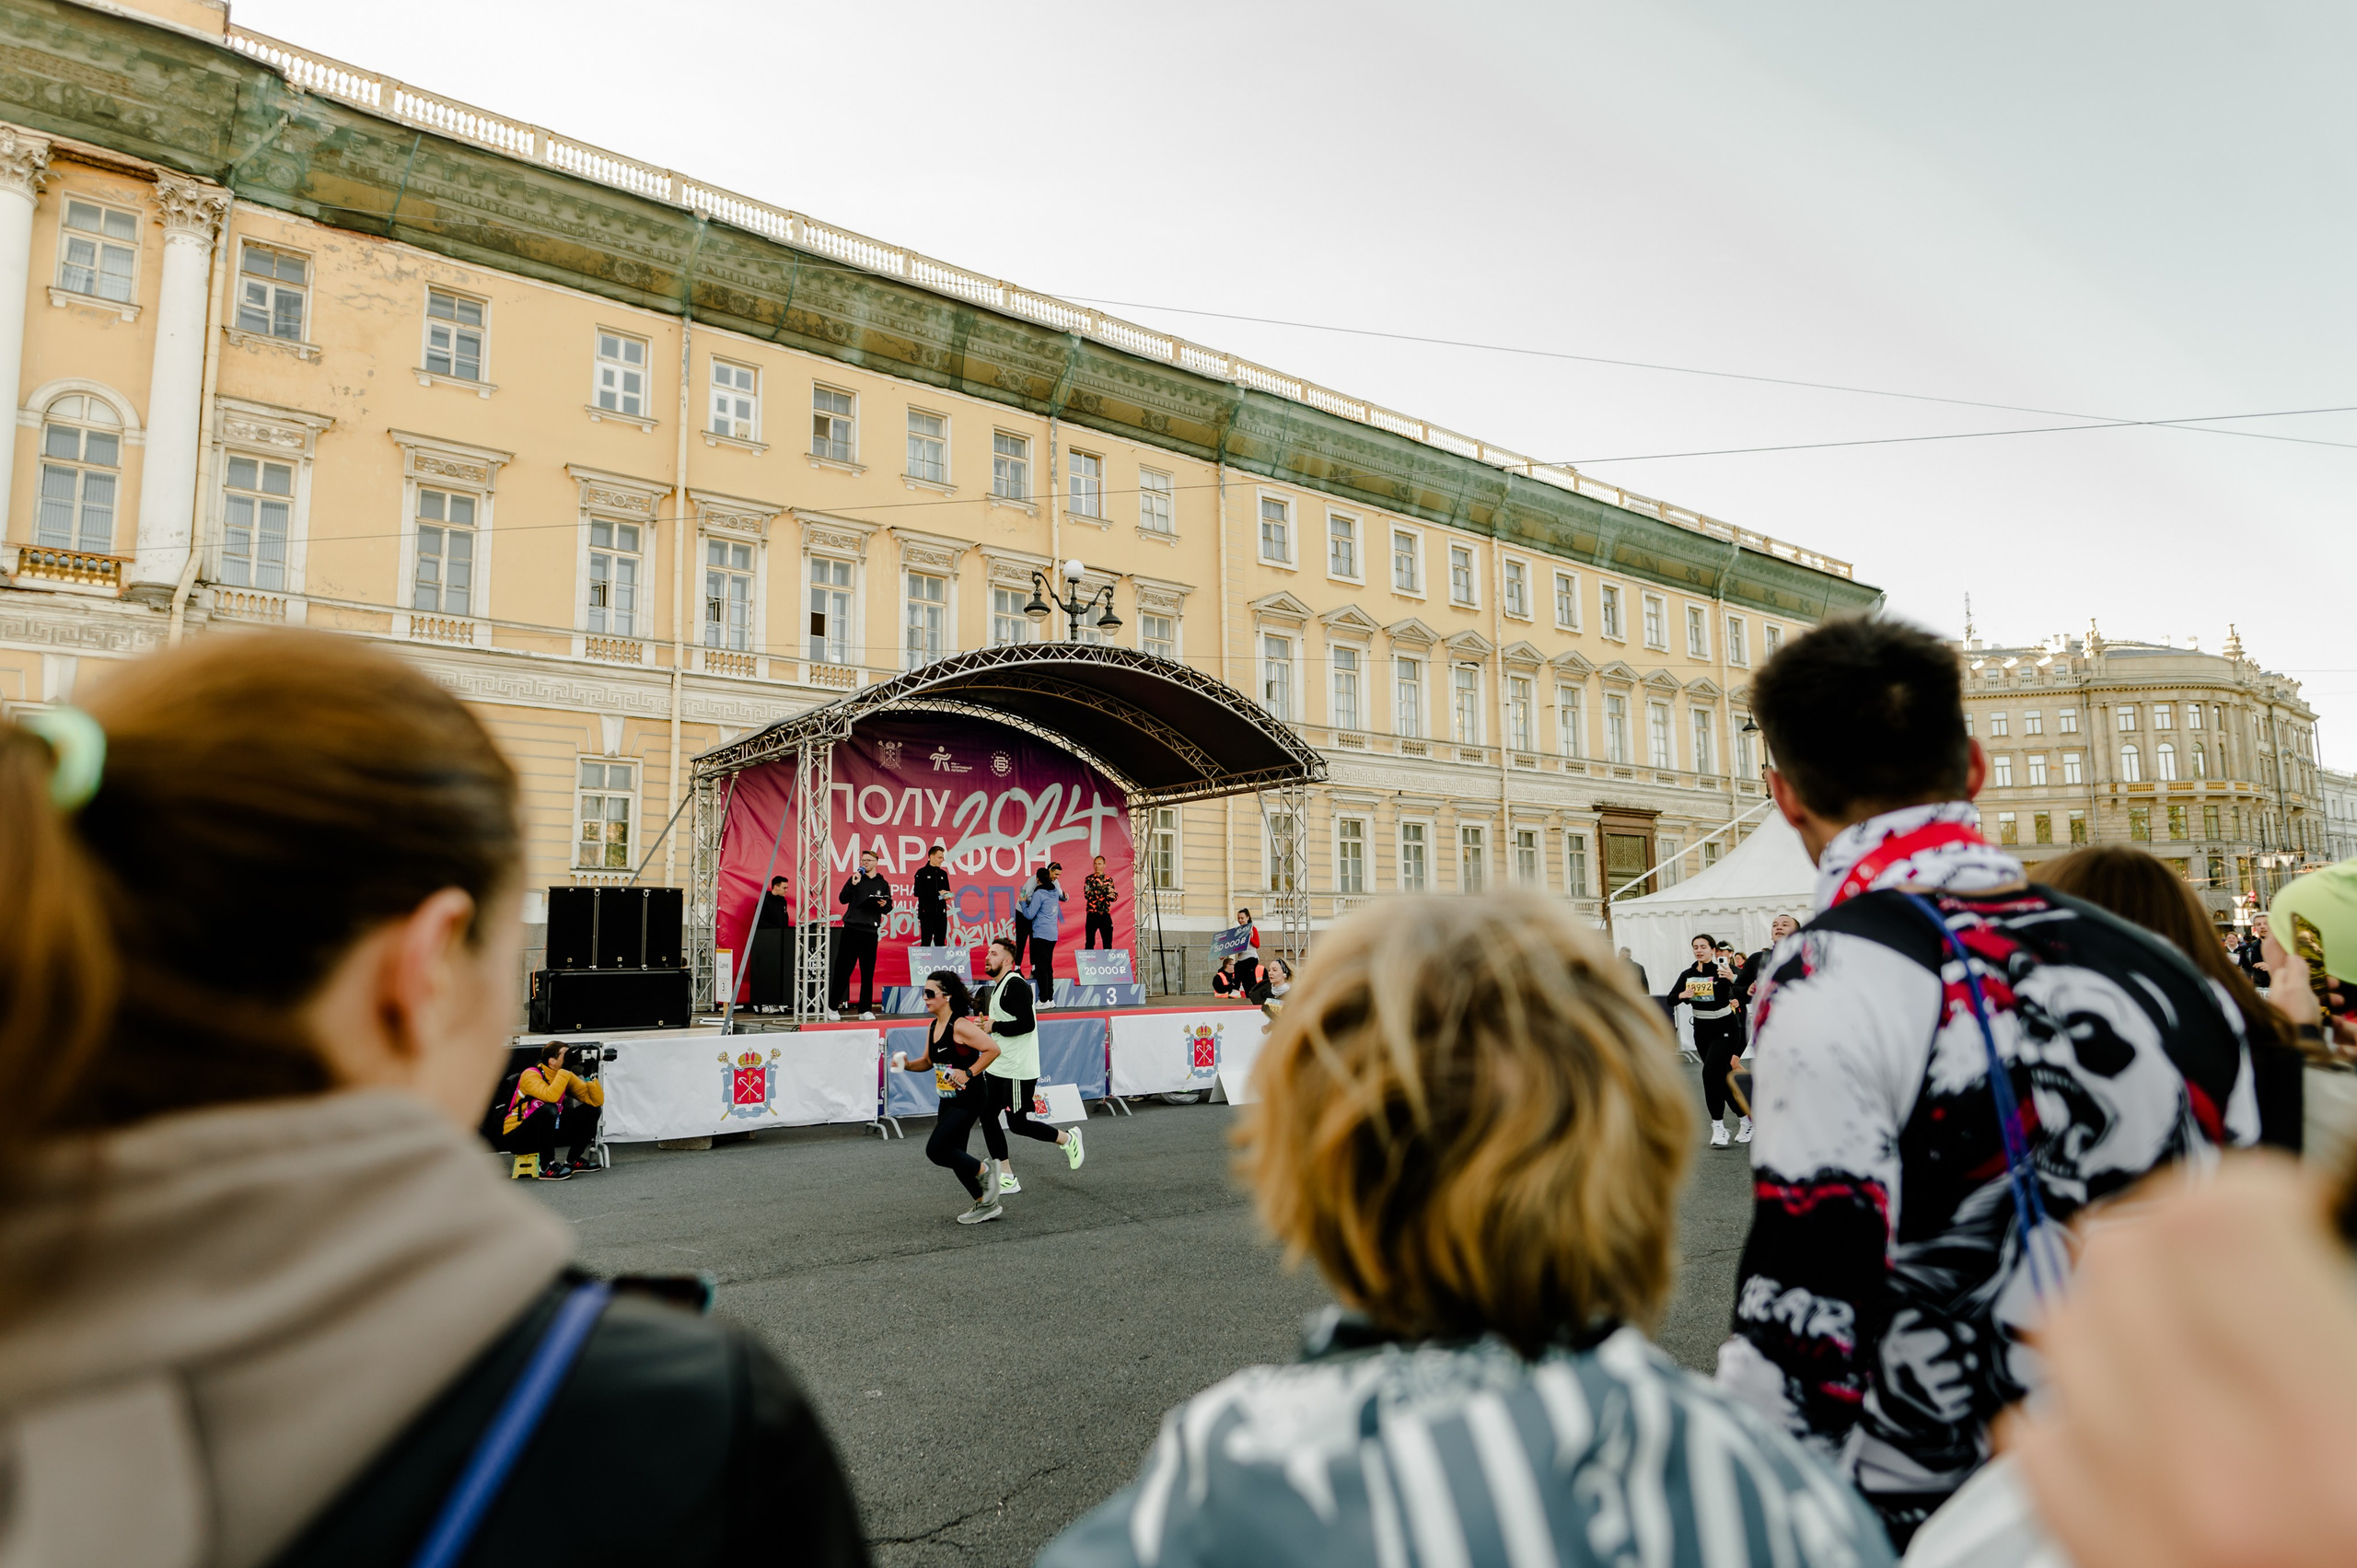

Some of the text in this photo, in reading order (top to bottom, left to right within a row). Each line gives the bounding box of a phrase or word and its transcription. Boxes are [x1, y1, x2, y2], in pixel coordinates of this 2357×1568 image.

[823, 783, 1119, 864] ПОЛУ 2024
[955, 885, 1065, 923] СП
[1214, 944, 1225, 953] 50
[917, 965, 931, 975] 30
[1084, 967, 1097, 975] 20
[1106, 987, 1118, 1005] 3
